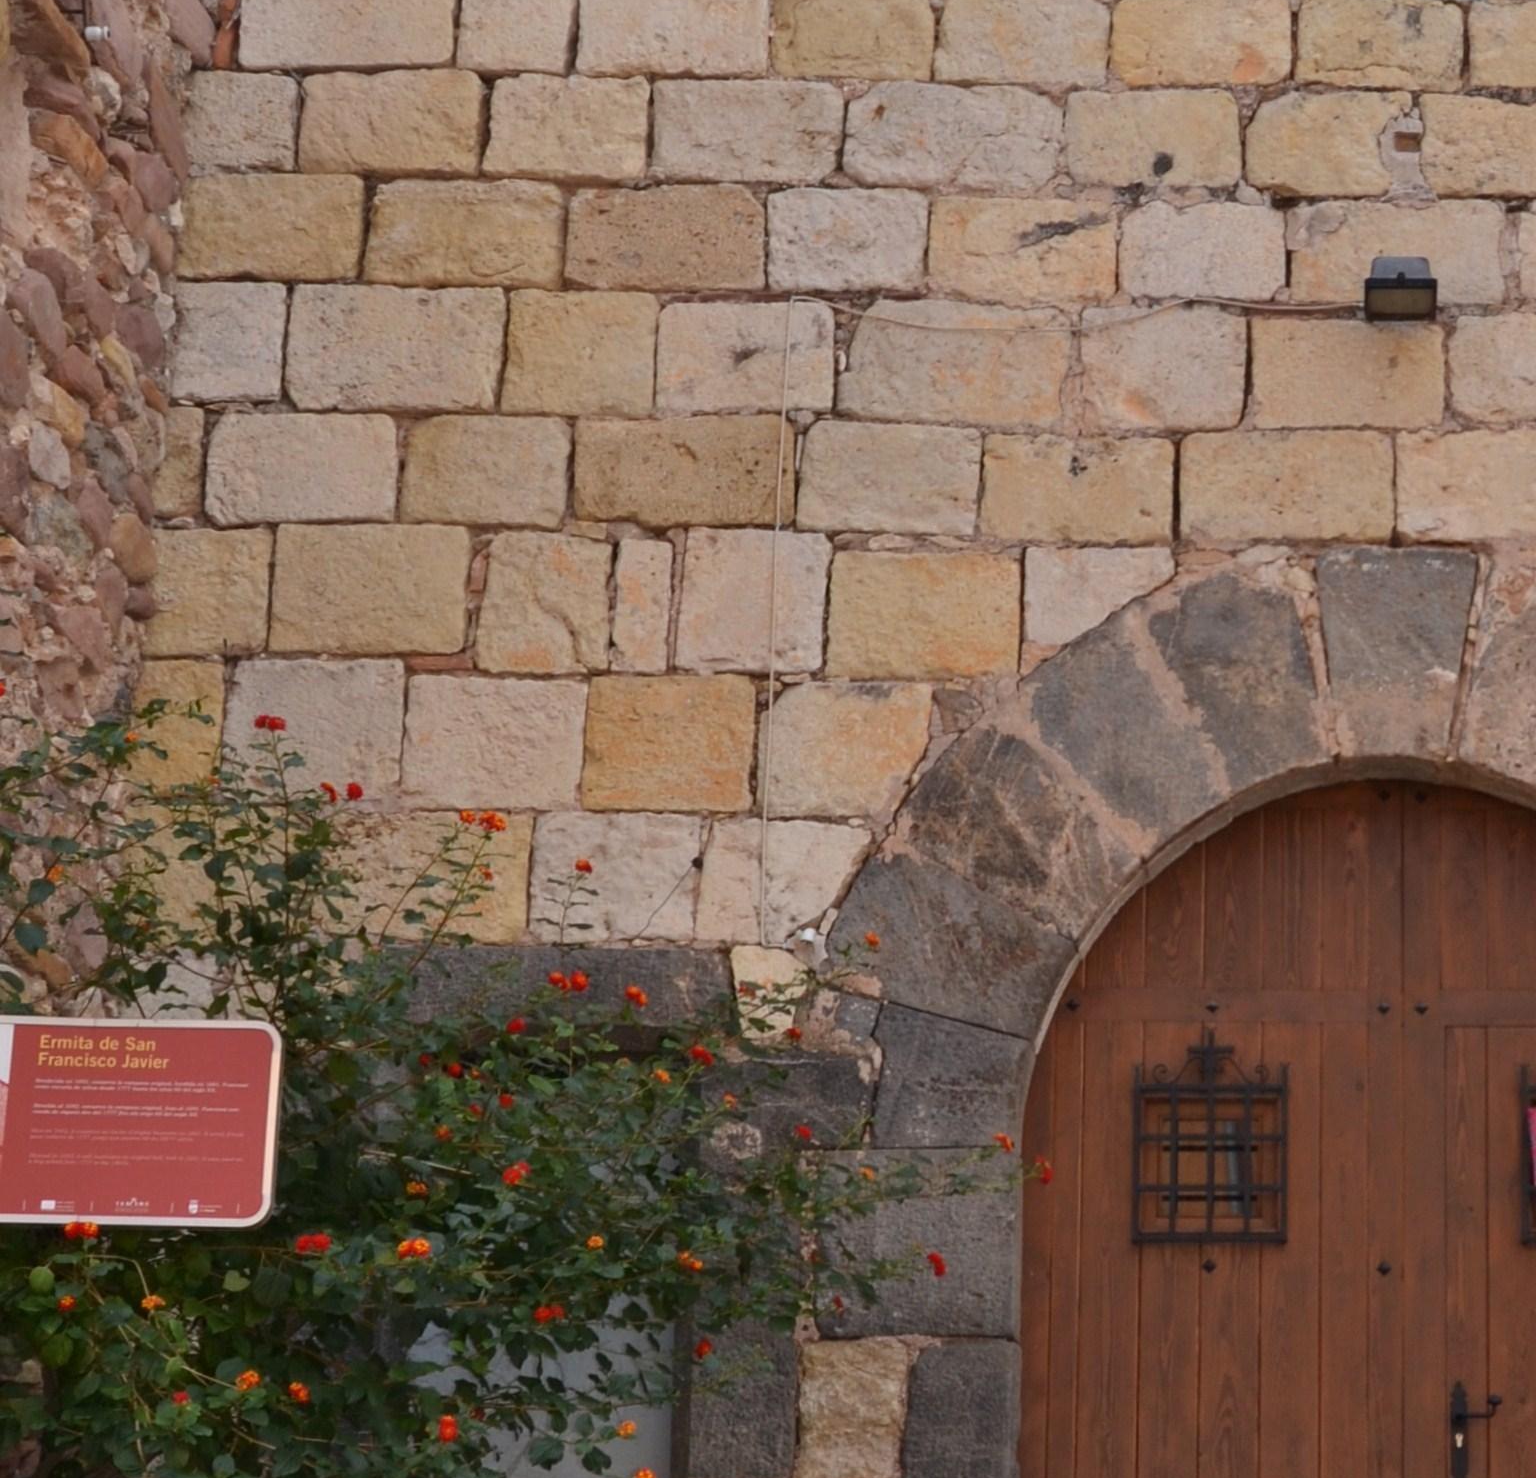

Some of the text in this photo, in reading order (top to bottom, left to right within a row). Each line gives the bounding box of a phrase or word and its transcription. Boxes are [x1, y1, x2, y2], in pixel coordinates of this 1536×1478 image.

[39, 1034, 156, 1052] Ermita de San
[37, 1052, 169, 1069] Francisco Javier
